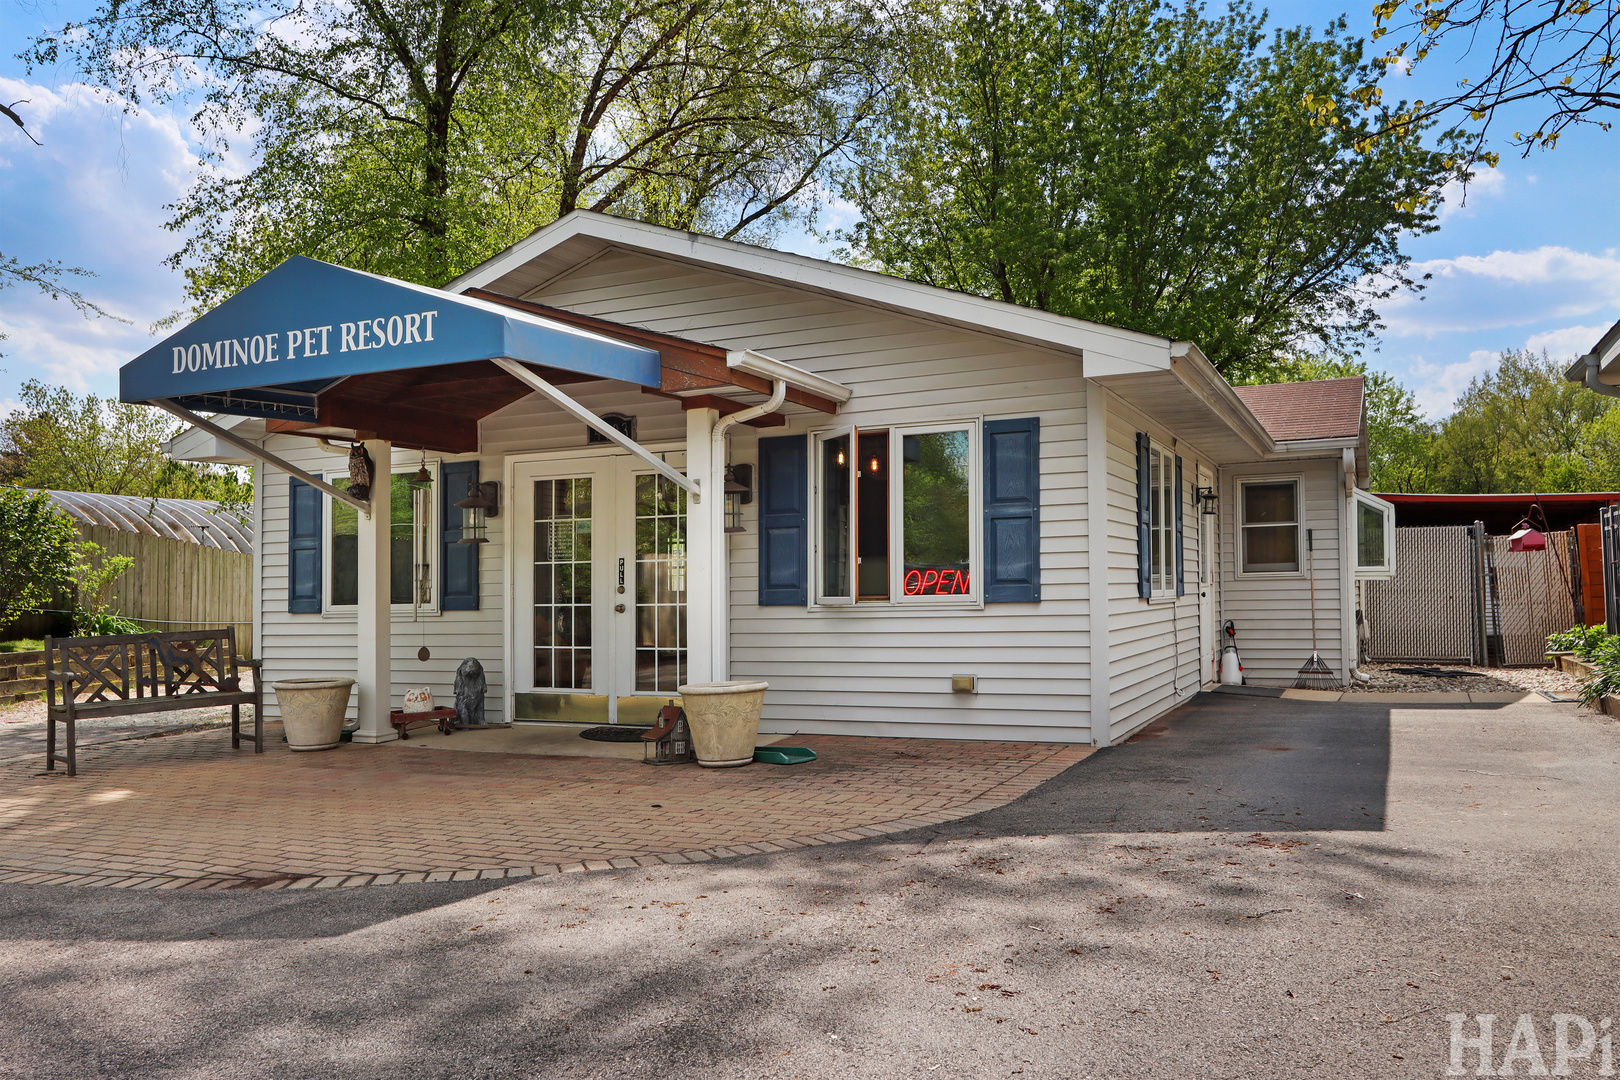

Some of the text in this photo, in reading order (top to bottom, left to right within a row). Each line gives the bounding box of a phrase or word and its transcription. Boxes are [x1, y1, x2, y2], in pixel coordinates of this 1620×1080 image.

[171, 310, 438, 374] DOMINOE PET RESORT
[904, 569, 970, 595] OPEN
